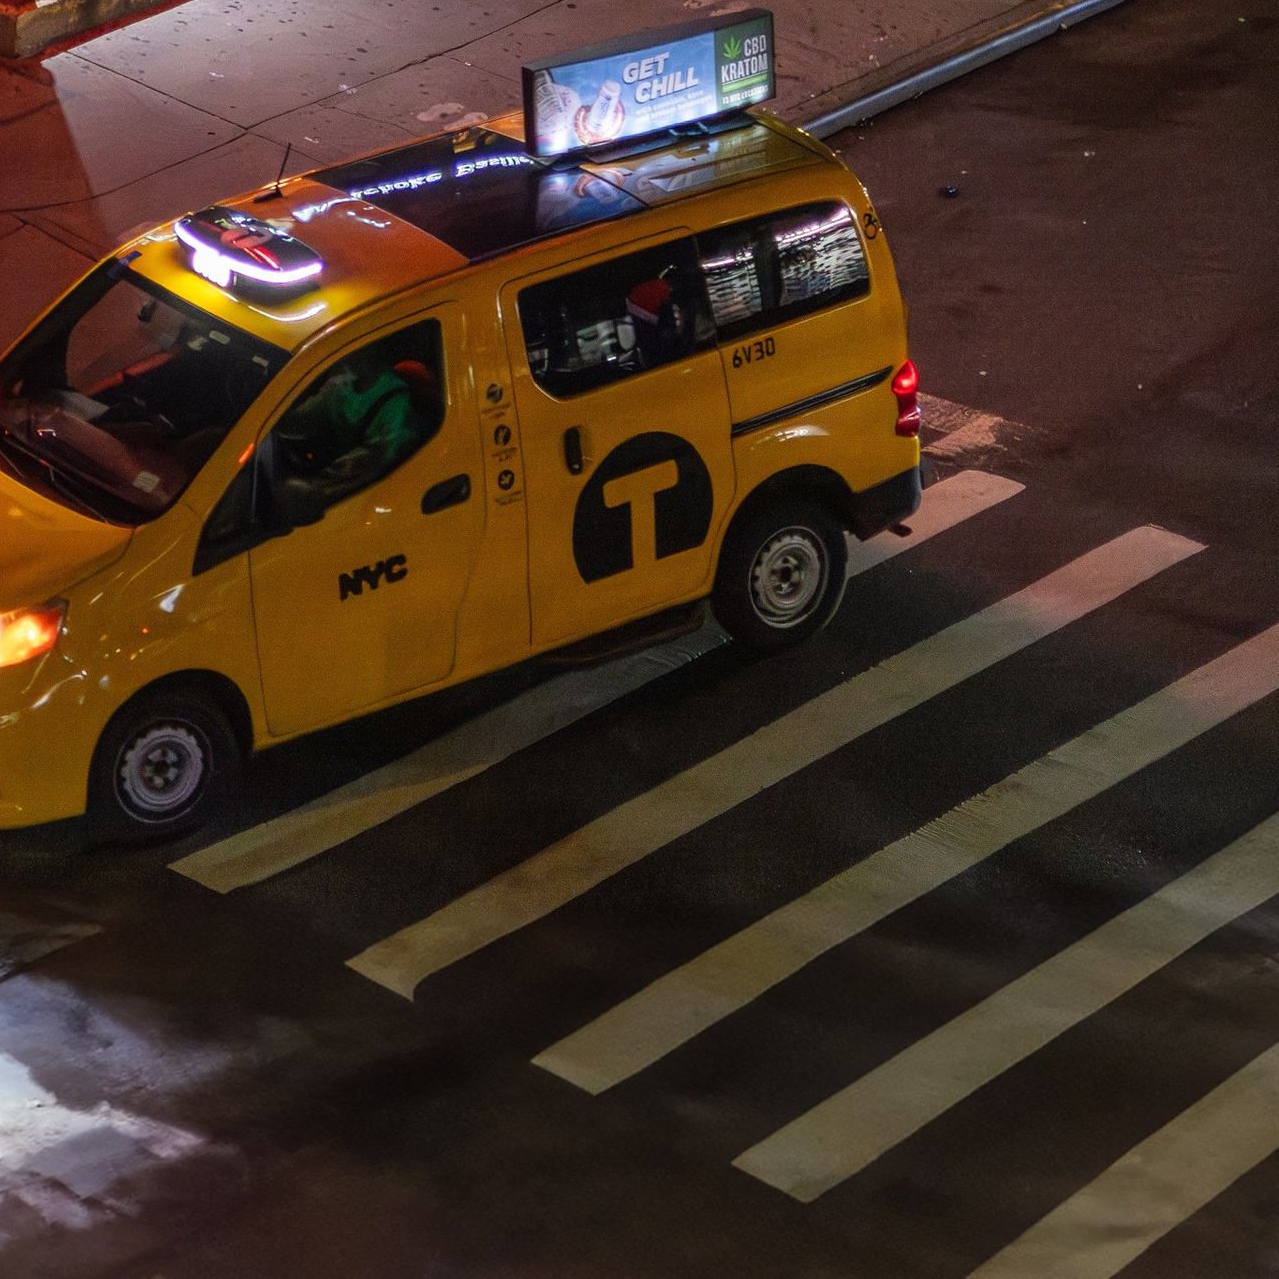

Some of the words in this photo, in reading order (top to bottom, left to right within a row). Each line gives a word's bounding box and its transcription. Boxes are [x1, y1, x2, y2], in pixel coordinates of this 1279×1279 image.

[743, 34, 767, 57] CBD
[622, 51, 670, 84] GET
[721, 53, 768, 83] KRATOM
[635, 67, 700, 103] CHILL
[731, 336, 777, 369] 6V30
[602, 459, 680, 570] T
[338, 554, 408, 601] NYC
